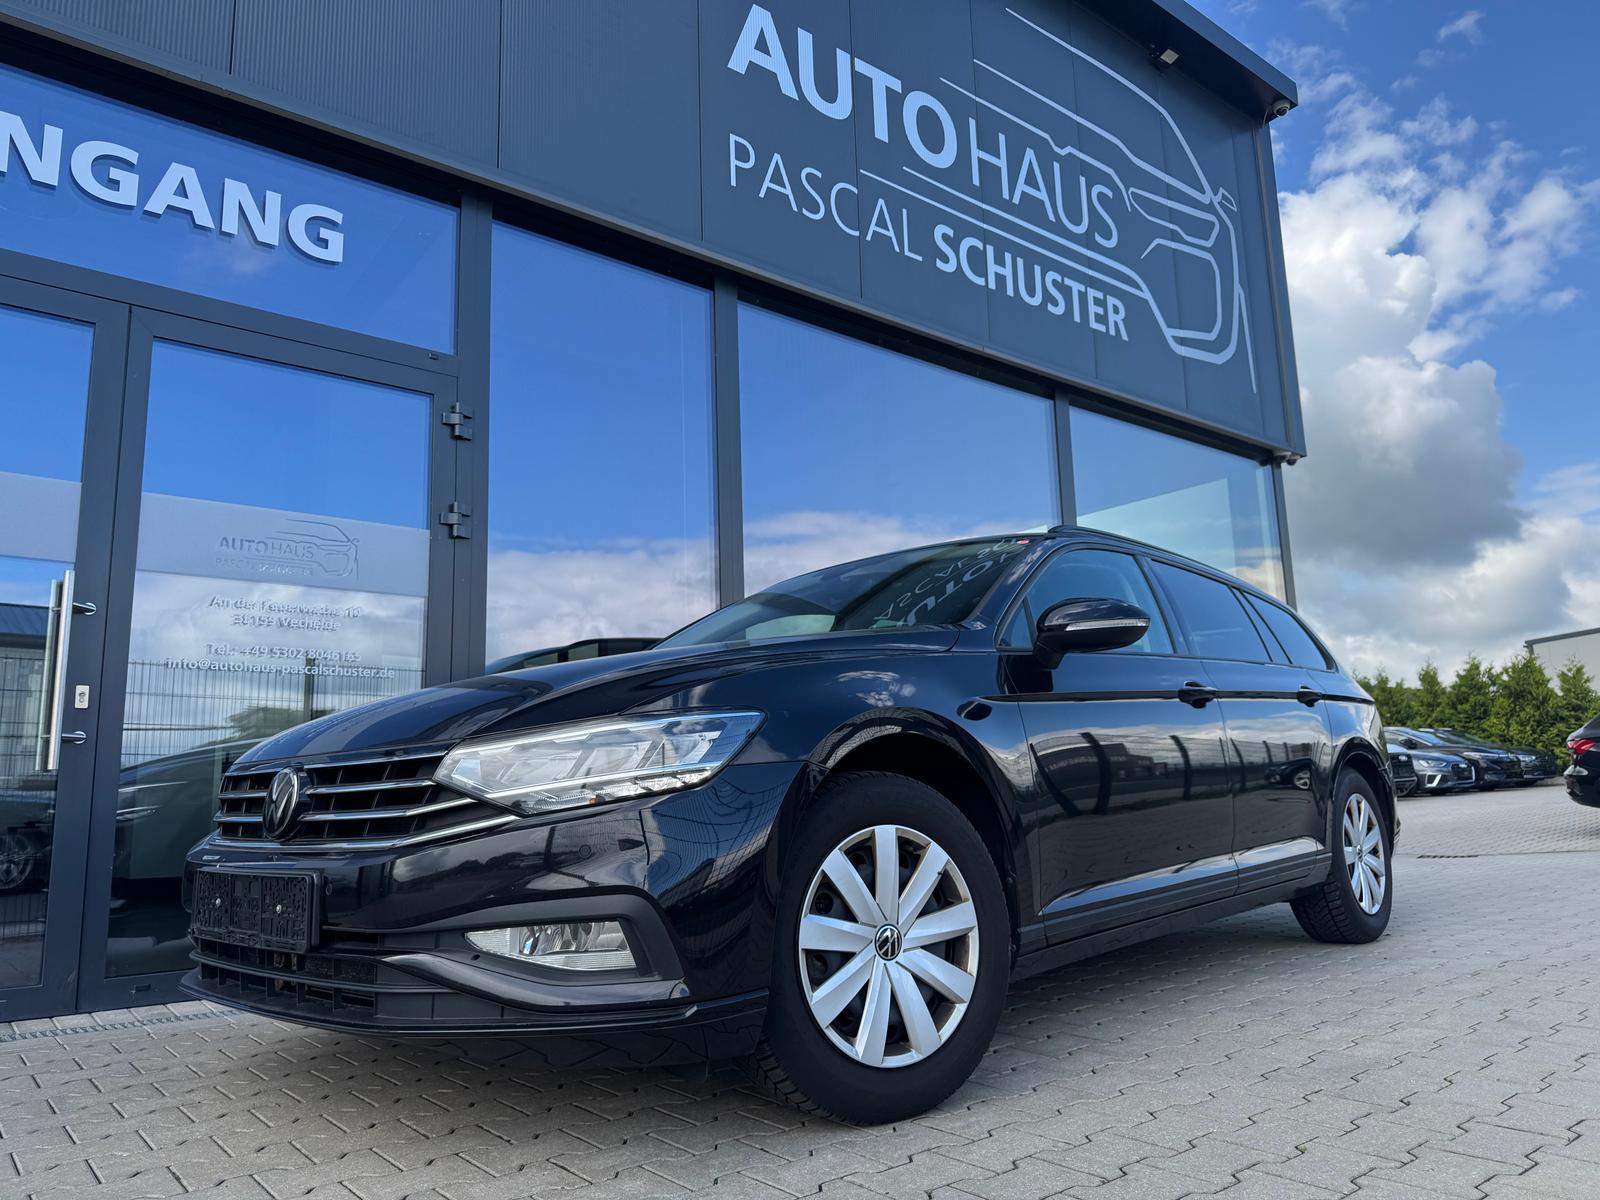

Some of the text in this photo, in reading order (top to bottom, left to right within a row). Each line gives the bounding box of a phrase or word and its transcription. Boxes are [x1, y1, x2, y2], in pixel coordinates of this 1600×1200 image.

[727, 4, 1119, 248] AUTOHAUS
[729, 133, 1129, 341] PASCAL SCHUSTER
[219, 536, 314, 560] AUTOHAUS
[166, 656, 395, 679] info@autohaus-pascalschuster.de
